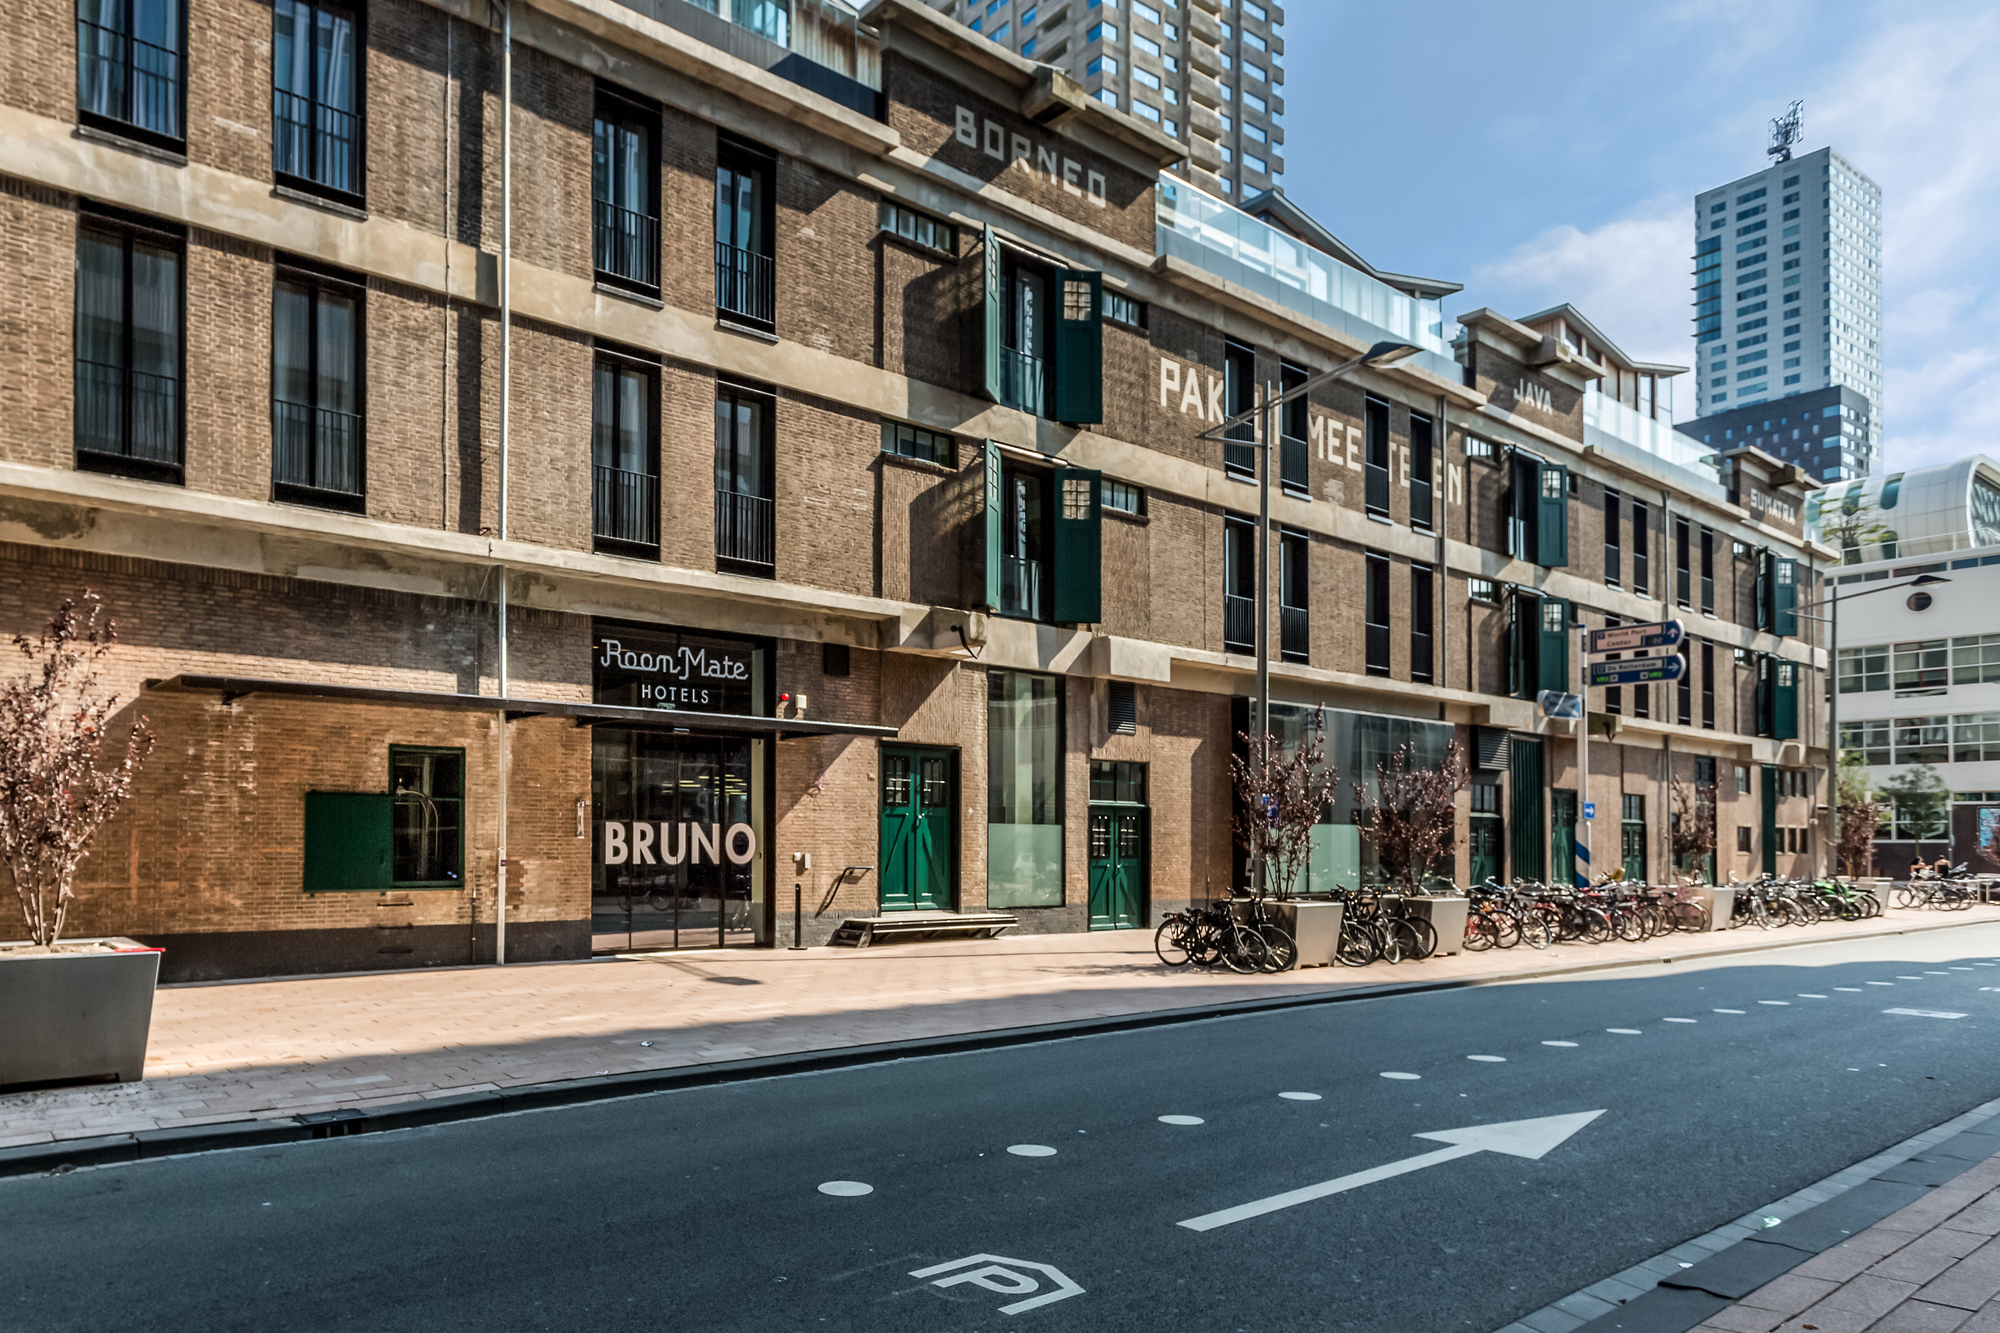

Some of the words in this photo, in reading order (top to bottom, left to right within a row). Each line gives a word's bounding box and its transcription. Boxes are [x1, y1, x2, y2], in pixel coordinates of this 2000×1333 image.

[956, 104, 1106, 209] BORNEO
[1513, 378, 1553, 415] JAVA
[1750, 488, 1796, 525] SUMATRA
[601, 639, 681, 673] Room
[677, 647, 749, 680] Mate
[1619, 662, 1657, 671] Rotterdam
[641, 684, 709, 704] HOTELS
[605, 821, 756, 865] BRUNO
